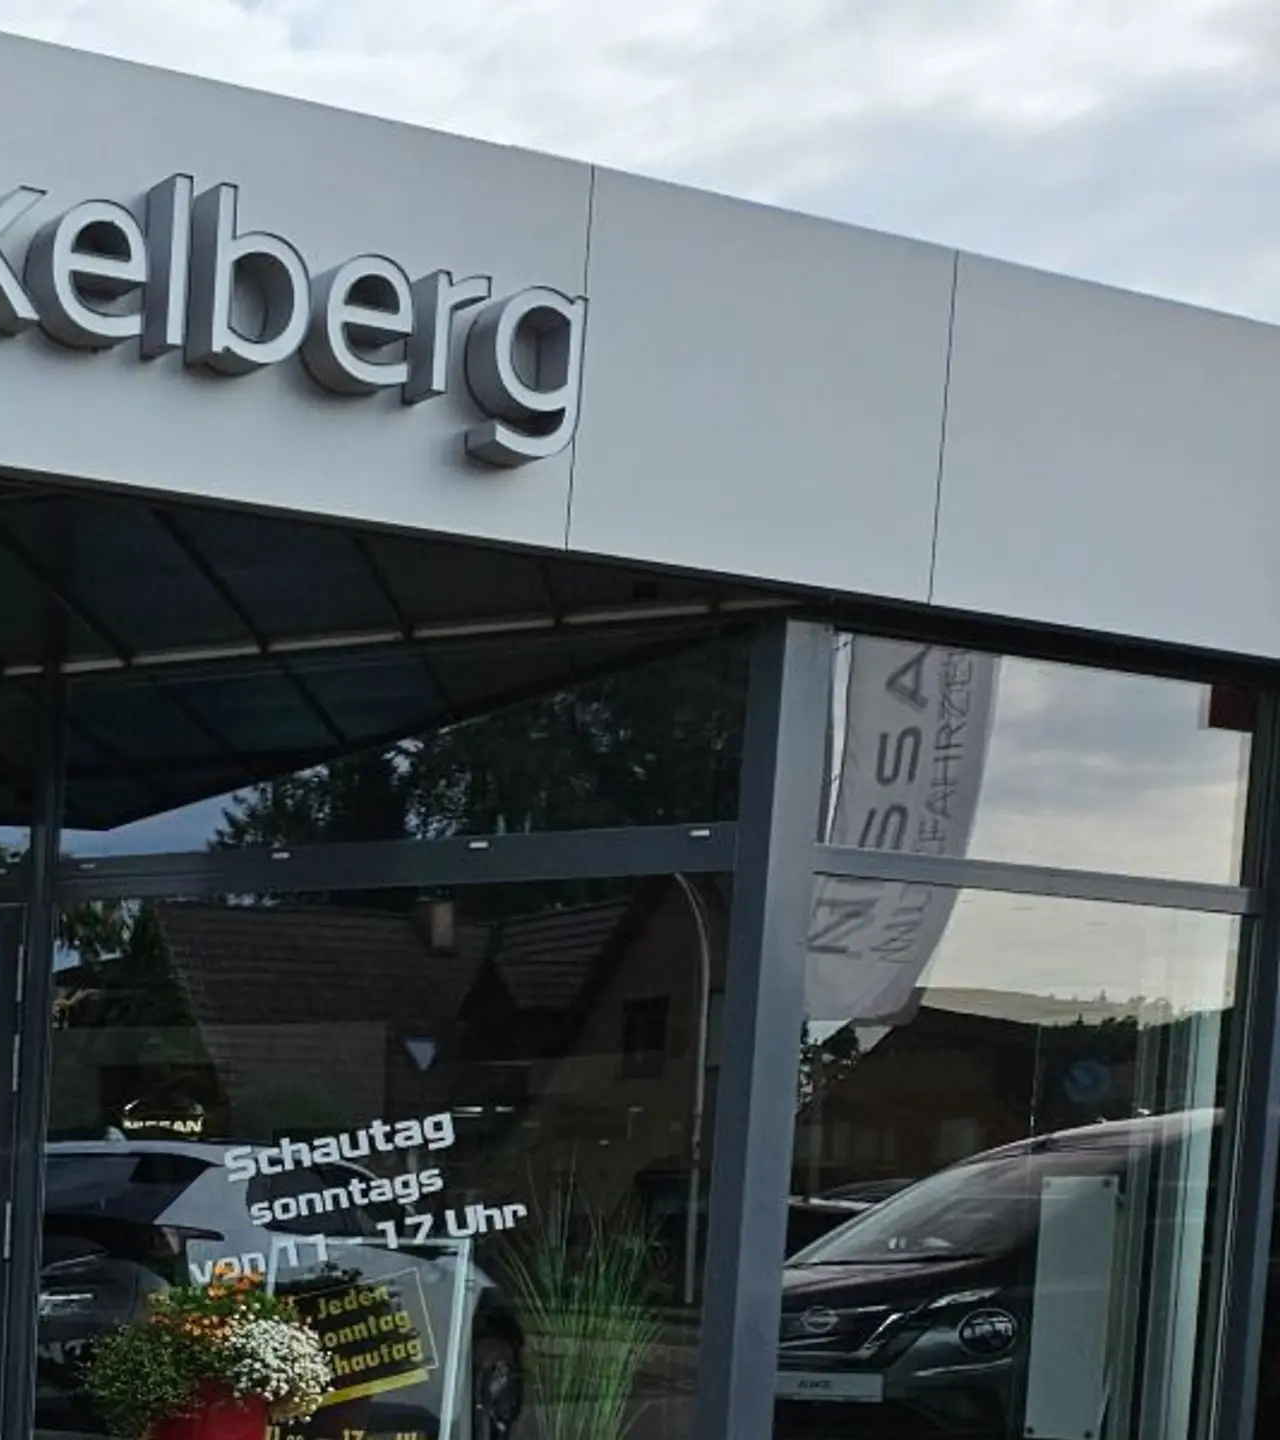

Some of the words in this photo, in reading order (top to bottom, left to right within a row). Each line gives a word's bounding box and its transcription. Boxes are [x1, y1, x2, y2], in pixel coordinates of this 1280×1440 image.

[224, 1112, 455, 1182] Schautag
[250, 1168, 444, 1226] sonntags
[445, 1203, 528, 1238] Uhr
[316, 1285, 391, 1318] Jeden
[322, 1310, 414, 1347] onntag
[332, 1338, 425, 1377] hautag
